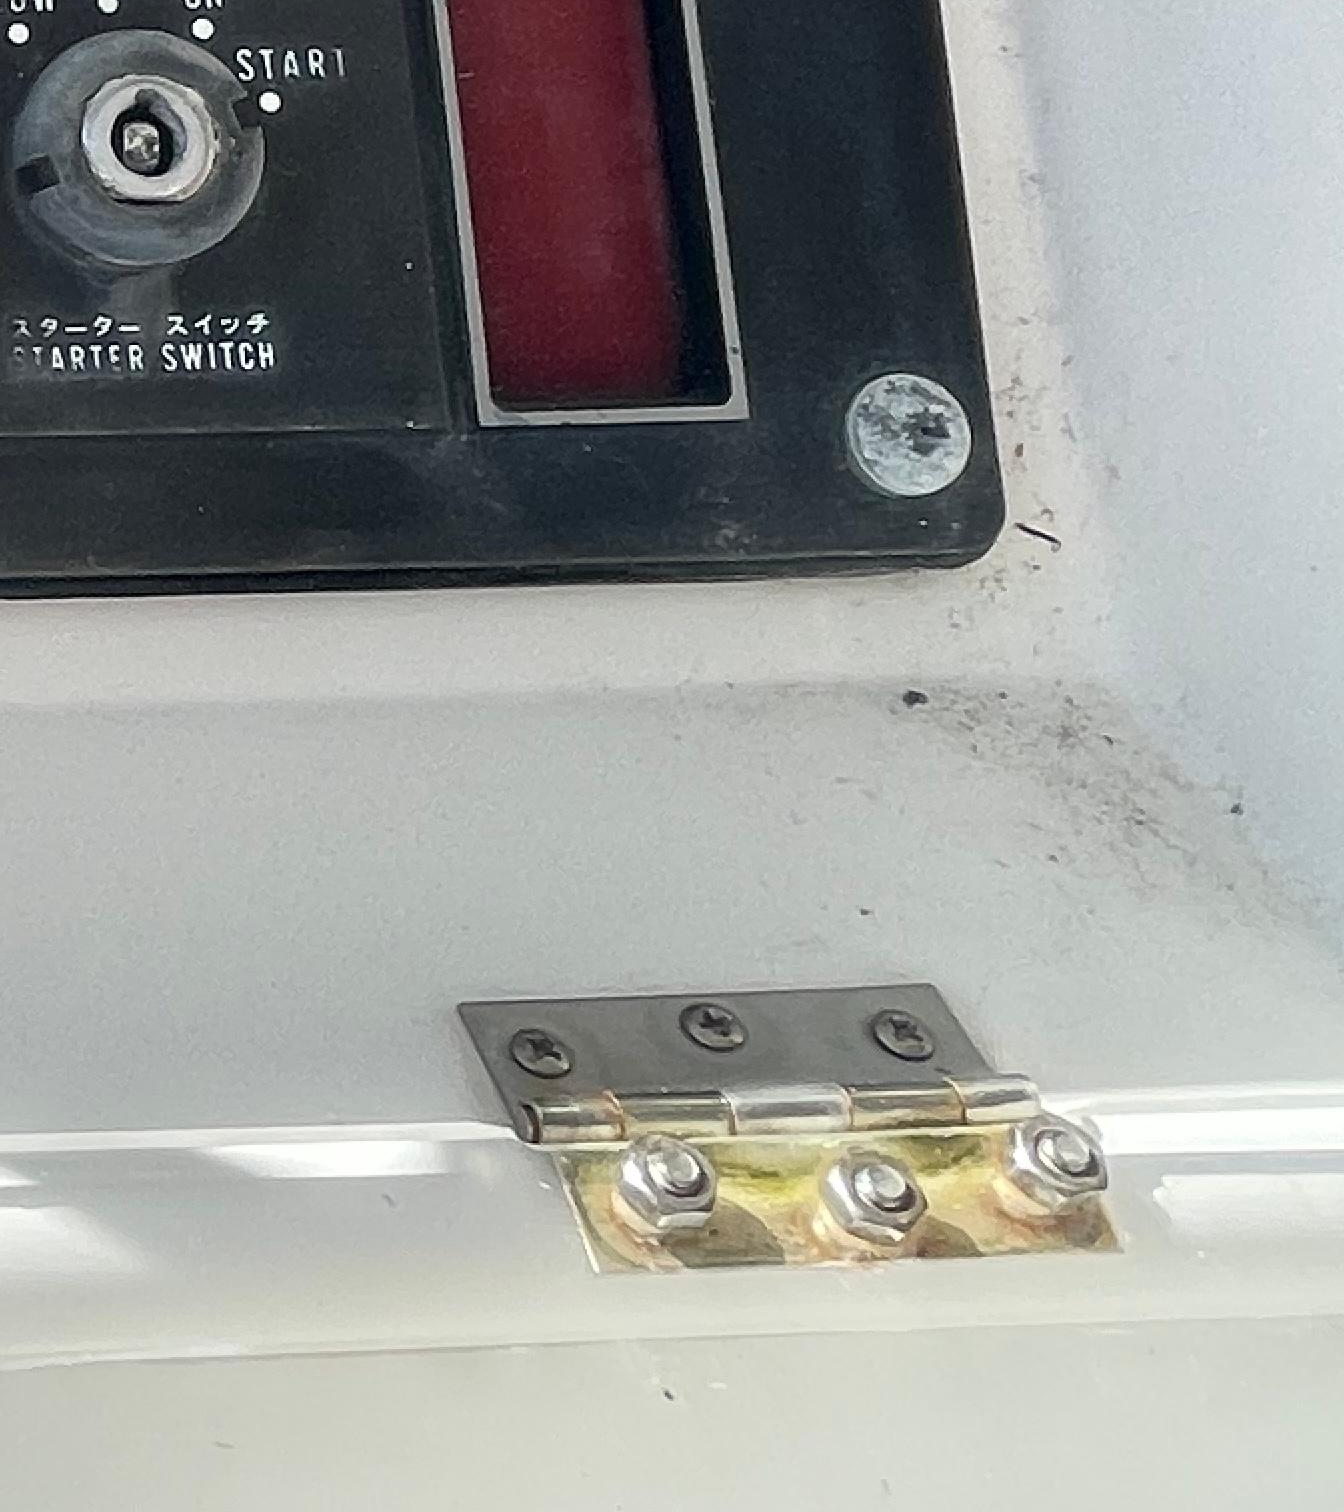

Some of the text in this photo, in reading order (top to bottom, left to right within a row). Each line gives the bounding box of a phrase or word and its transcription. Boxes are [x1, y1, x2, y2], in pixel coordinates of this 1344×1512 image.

[13, 313, 272, 339] スターター スイッチ
[12, 341, 275, 372] STARTER SWITCH
